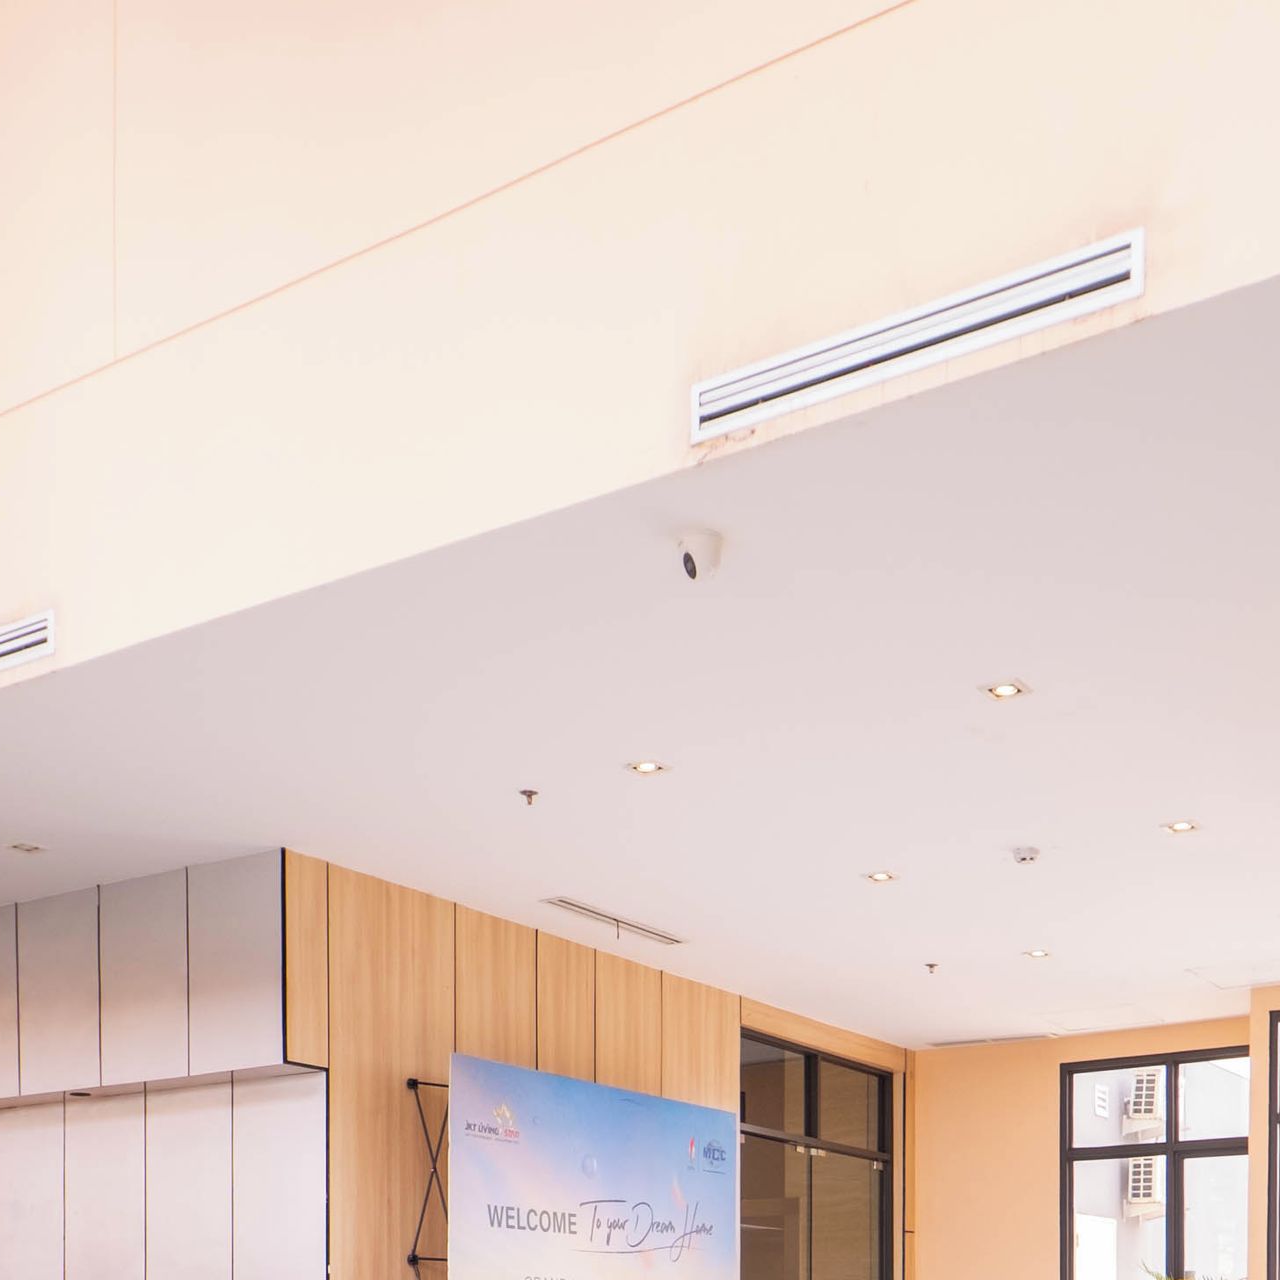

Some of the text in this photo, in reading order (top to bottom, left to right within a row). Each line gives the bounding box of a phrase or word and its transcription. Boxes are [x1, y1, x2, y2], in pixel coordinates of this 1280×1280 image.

[465, 1120, 477, 1131] JKT
[703, 1146, 727, 1161] MCC
[487, 1204, 578, 1235] WELCOME
[607, 1215, 628, 1246] your
[626, 1201, 675, 1248] Dream
[670, 1201, 713, 1262] Home
